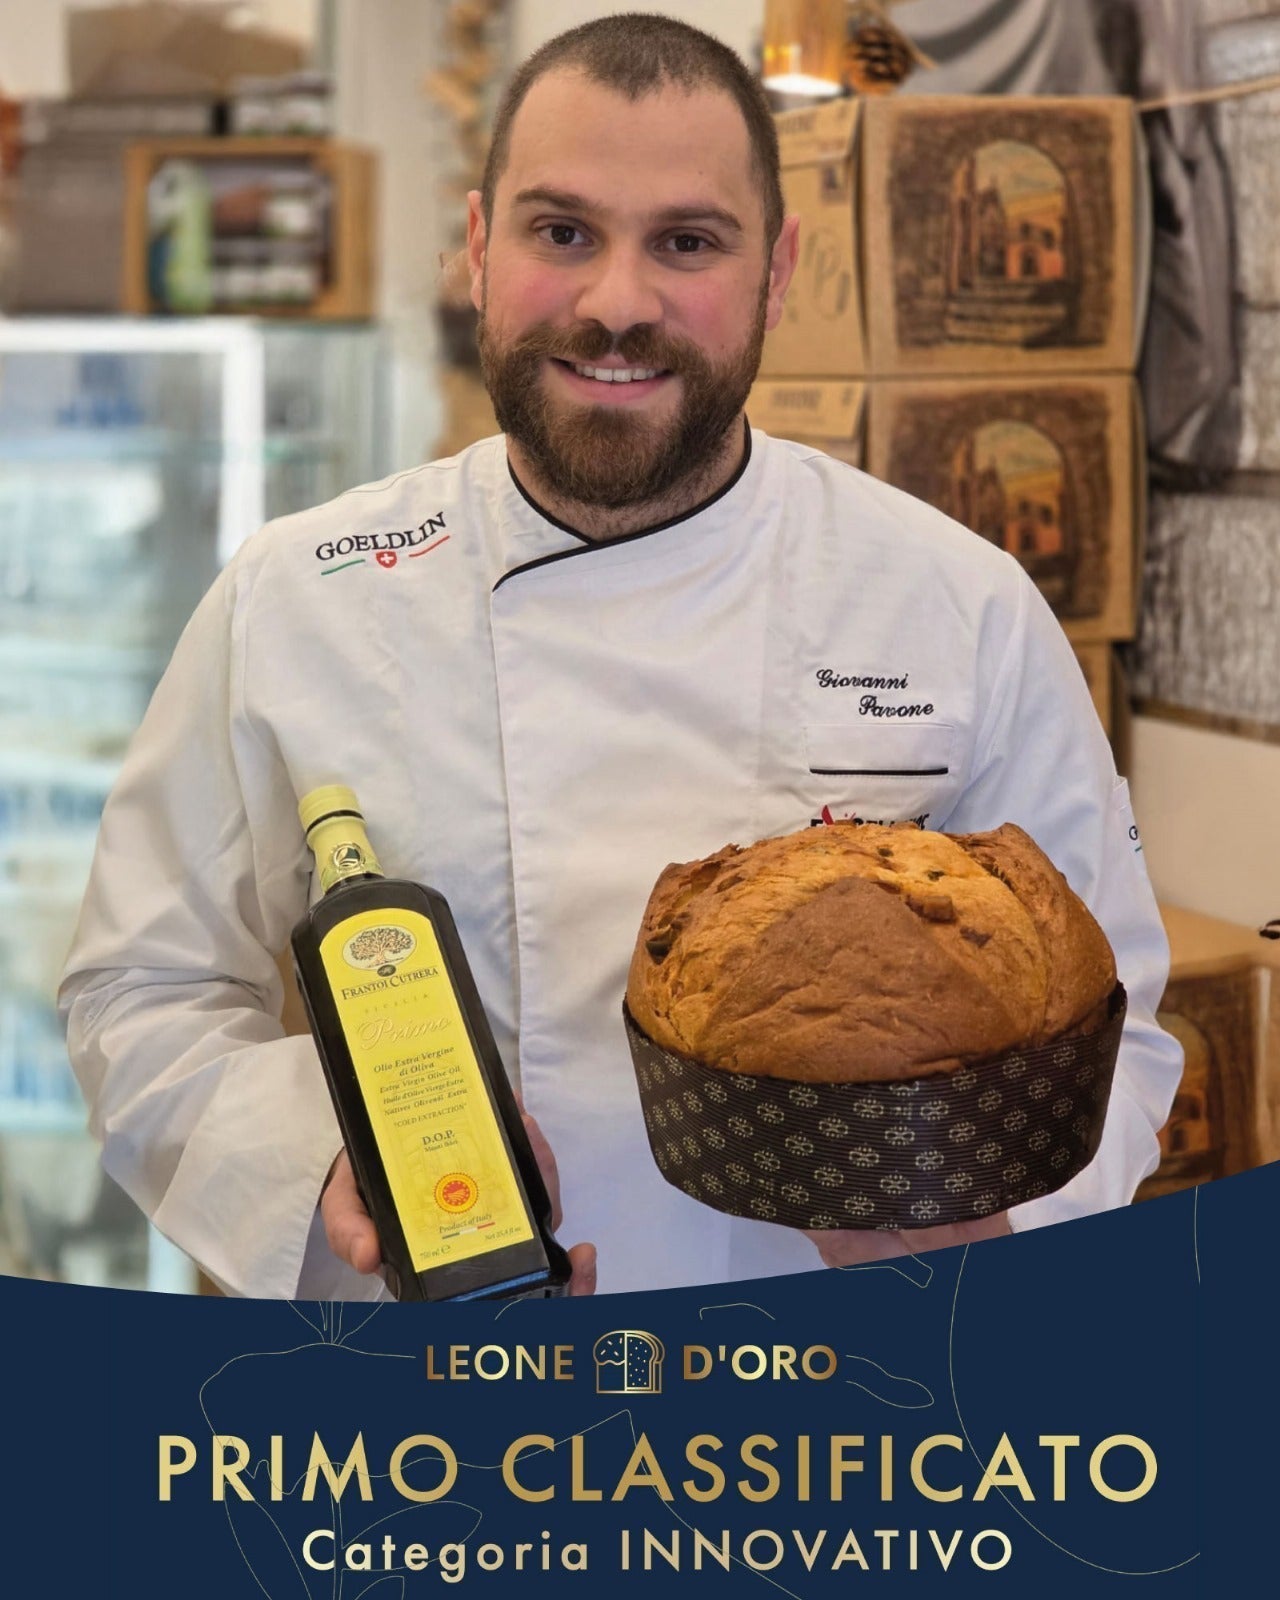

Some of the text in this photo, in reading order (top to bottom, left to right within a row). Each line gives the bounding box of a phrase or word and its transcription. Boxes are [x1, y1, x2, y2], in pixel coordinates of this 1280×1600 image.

[315, 511, 447, 560] GOELDLIN
[816, 669, 909, 689] Giovanni
[858, 695, 934, 717] Pavone
[341, 967, 439, 1000] FRANTOI CUTRERA
[357, 1016, 451, 1051] Primo
[373, 1046, 455, 1074] Olio Extra Vergine
[399, 1062, 435, 1077] di Oliva
[427, 1071, 447, 1081] Olive
[422, 1129, 455, 1145] D.O.P.
